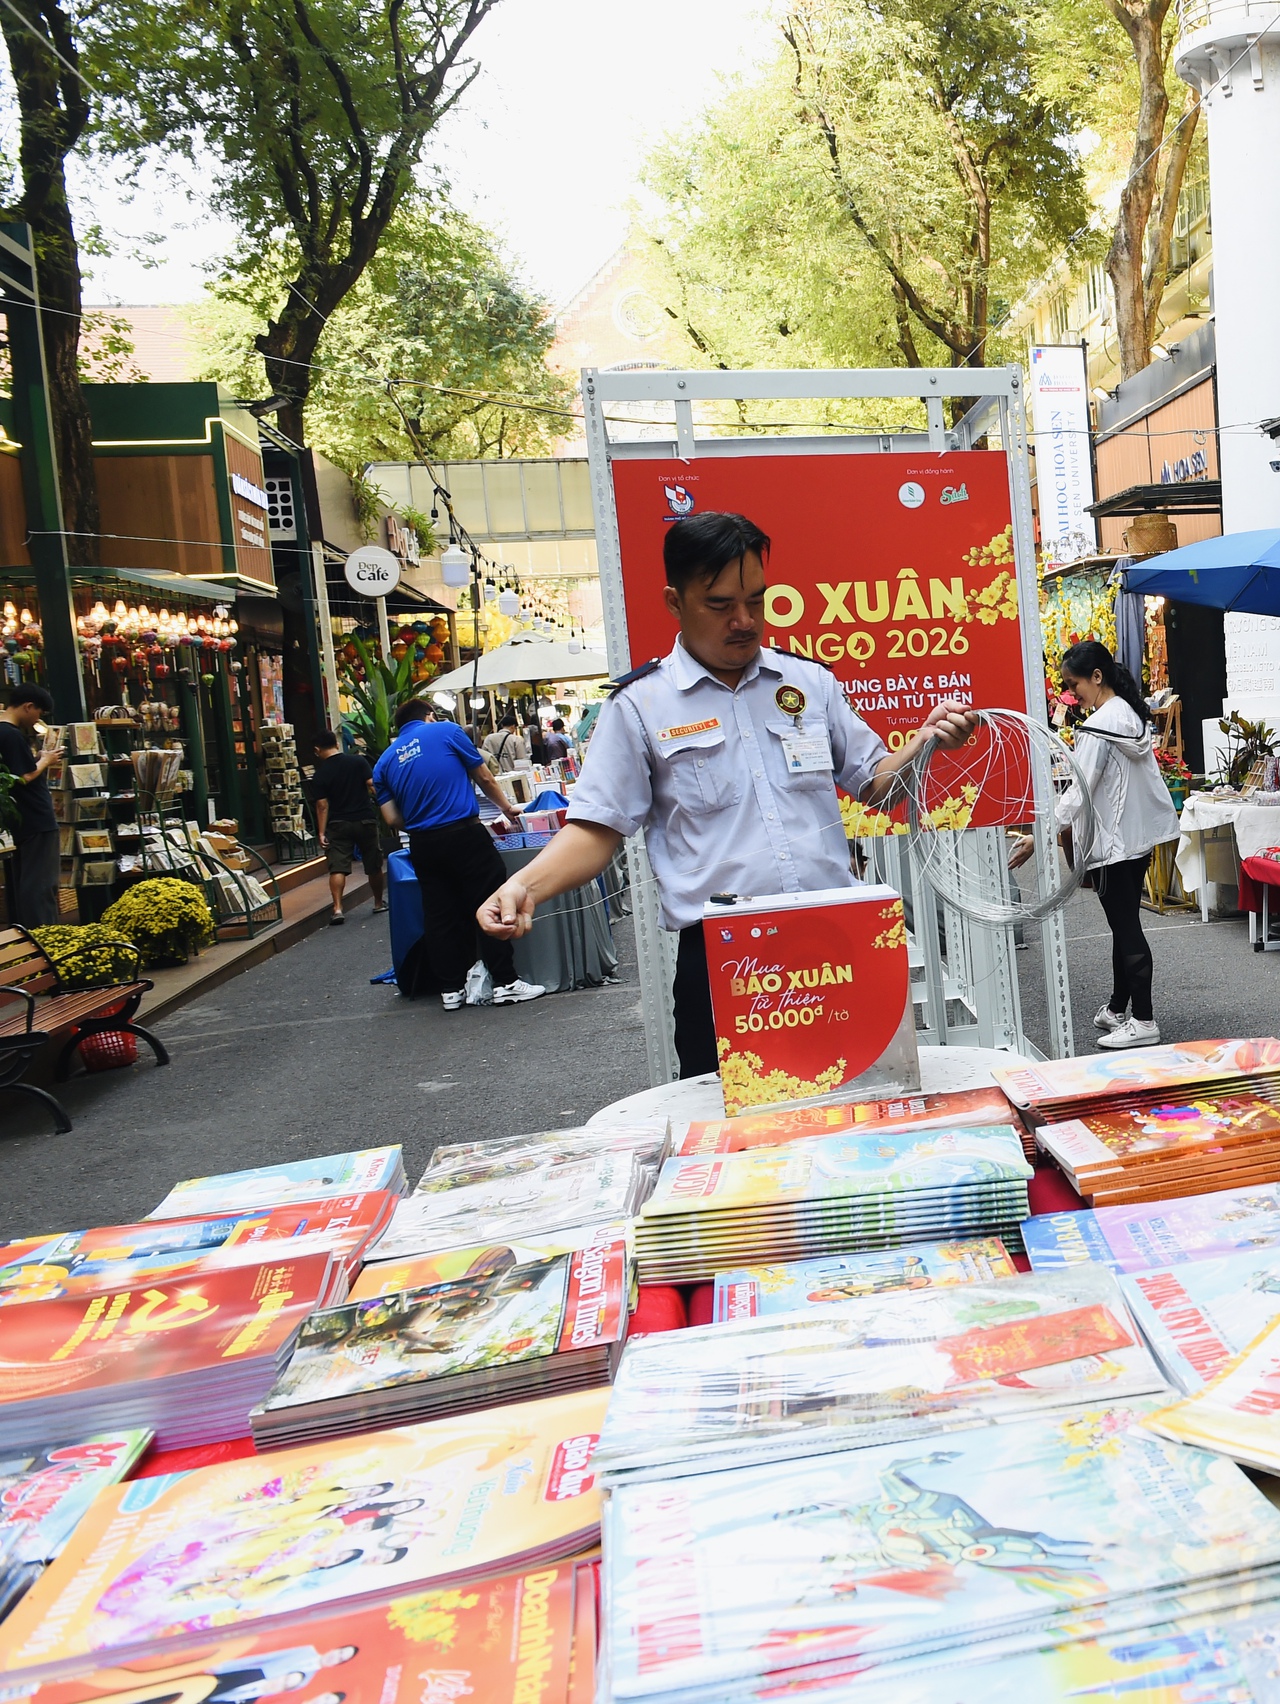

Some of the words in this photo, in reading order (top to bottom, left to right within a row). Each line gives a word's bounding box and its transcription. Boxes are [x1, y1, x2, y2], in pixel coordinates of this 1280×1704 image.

[1051, 410, 1064, 441] SEN
[1053, 443, 1067, 477] HOA
[1067, 410, 1081, 488] UNIVERSITY
[1073, 493, 1082, 517] SEN
[356, 567, 389, 581] Café
[815, 568, 966, 625] XUÂN
[886, 627, 970, 659] 2026
[840, 678, 882, 695] RƯNG
[886, 673, 919, 692] BÀY
[923, 675, 935, 690] &
[938, 671, 971, 688] BÁN
[854, 694, 900, 712] XUÂN
[903, 692, 924, 710] TỪ
[670, 723, 704, 737] SECURITY
[899, 716, 919, 724] mua
[720, 956, 785, 980] Mua
[730, 971, 782, 997] BÁO
[787, 962, 853, 990] XUÂN
[749, 992, 774, 1016] từ
[777, 988, 826, 1013] thiện
[1050, 1215, 1083, 1242] BÁO
[574, 1243, 612, 1294] Saigon
[571, 1291, 609, 1345] Times
[562, 1436, 597, 1471] giáo
[551, 1467, 596, 1500] dục
